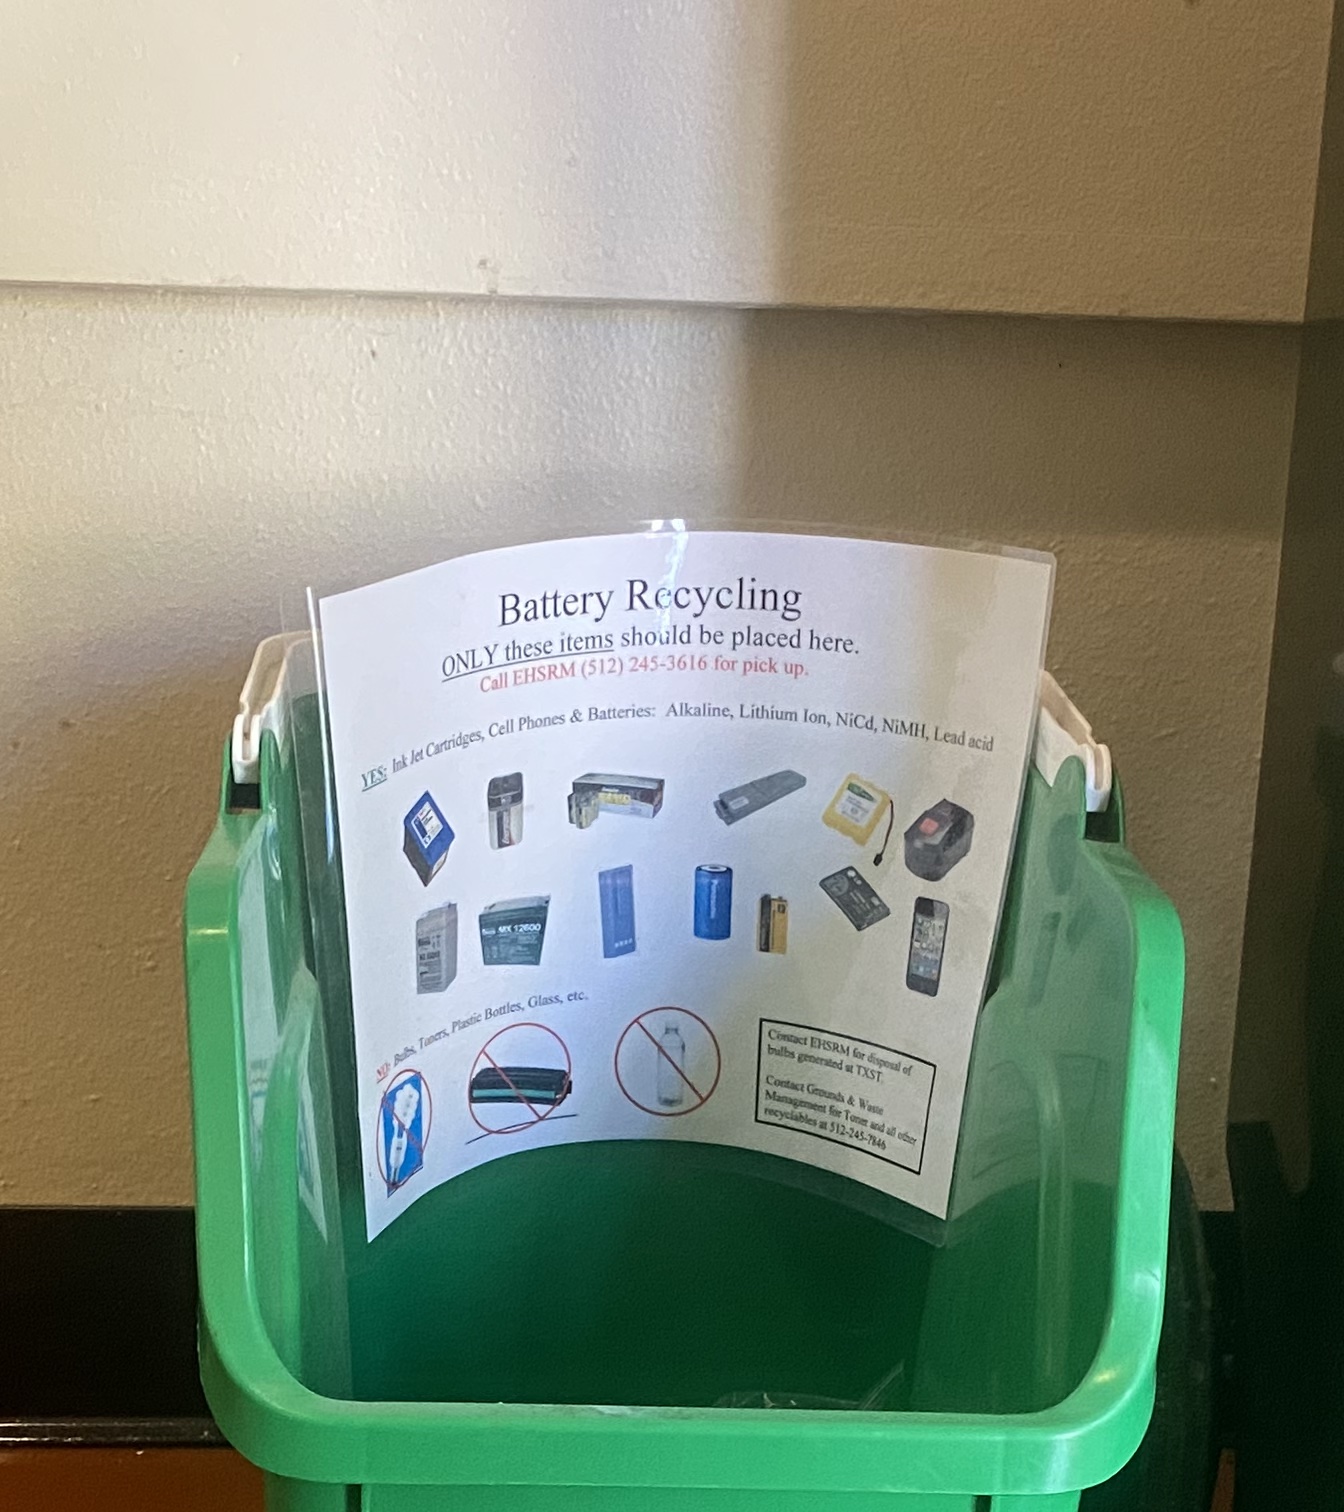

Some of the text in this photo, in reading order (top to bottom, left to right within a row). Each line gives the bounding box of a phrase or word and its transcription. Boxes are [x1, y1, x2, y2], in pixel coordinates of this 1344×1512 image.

[498, 577, 803, 627] Battery Recycling
[442, 624, 860, 677] ONLY these items should be placed here.
[480, 654, 809, 693] Call EHSRM (512) 245-3616 for pick up.
[361, 702, 994, 787] YES: Ink Jet Cartridges, Cell Phones & Batteries: Alkaline, Lithium Ion, NiCd, NiMH, Lead acid
[451, 1012, 482, 1034] Plastic
[484, 1000, 525, 1020] Bottles,
[527, 994, 563, 1009] Glass,
[567, 990, 590, 1002] etc.
[767, 1044, 796, 1059] bulbs
[797, 1051, 843, 1071] generated
[845, 1062, 854, 1074] at
[768, 1028, 914, 1077] Contact EHSRM for disposal of
[765, 1089, 826, 1114] Management
[829, 1104, 842, 1119] for
[869, 1118, 885, 1133] and
[766, 1075, 805, 1093] Contact
[847, 1096, 855, 1107] &
[859, 1097, 884, 1116] Waste
[764, 1106, 817, 1128] recyclables
[819, 1119, 827, 1130] at
